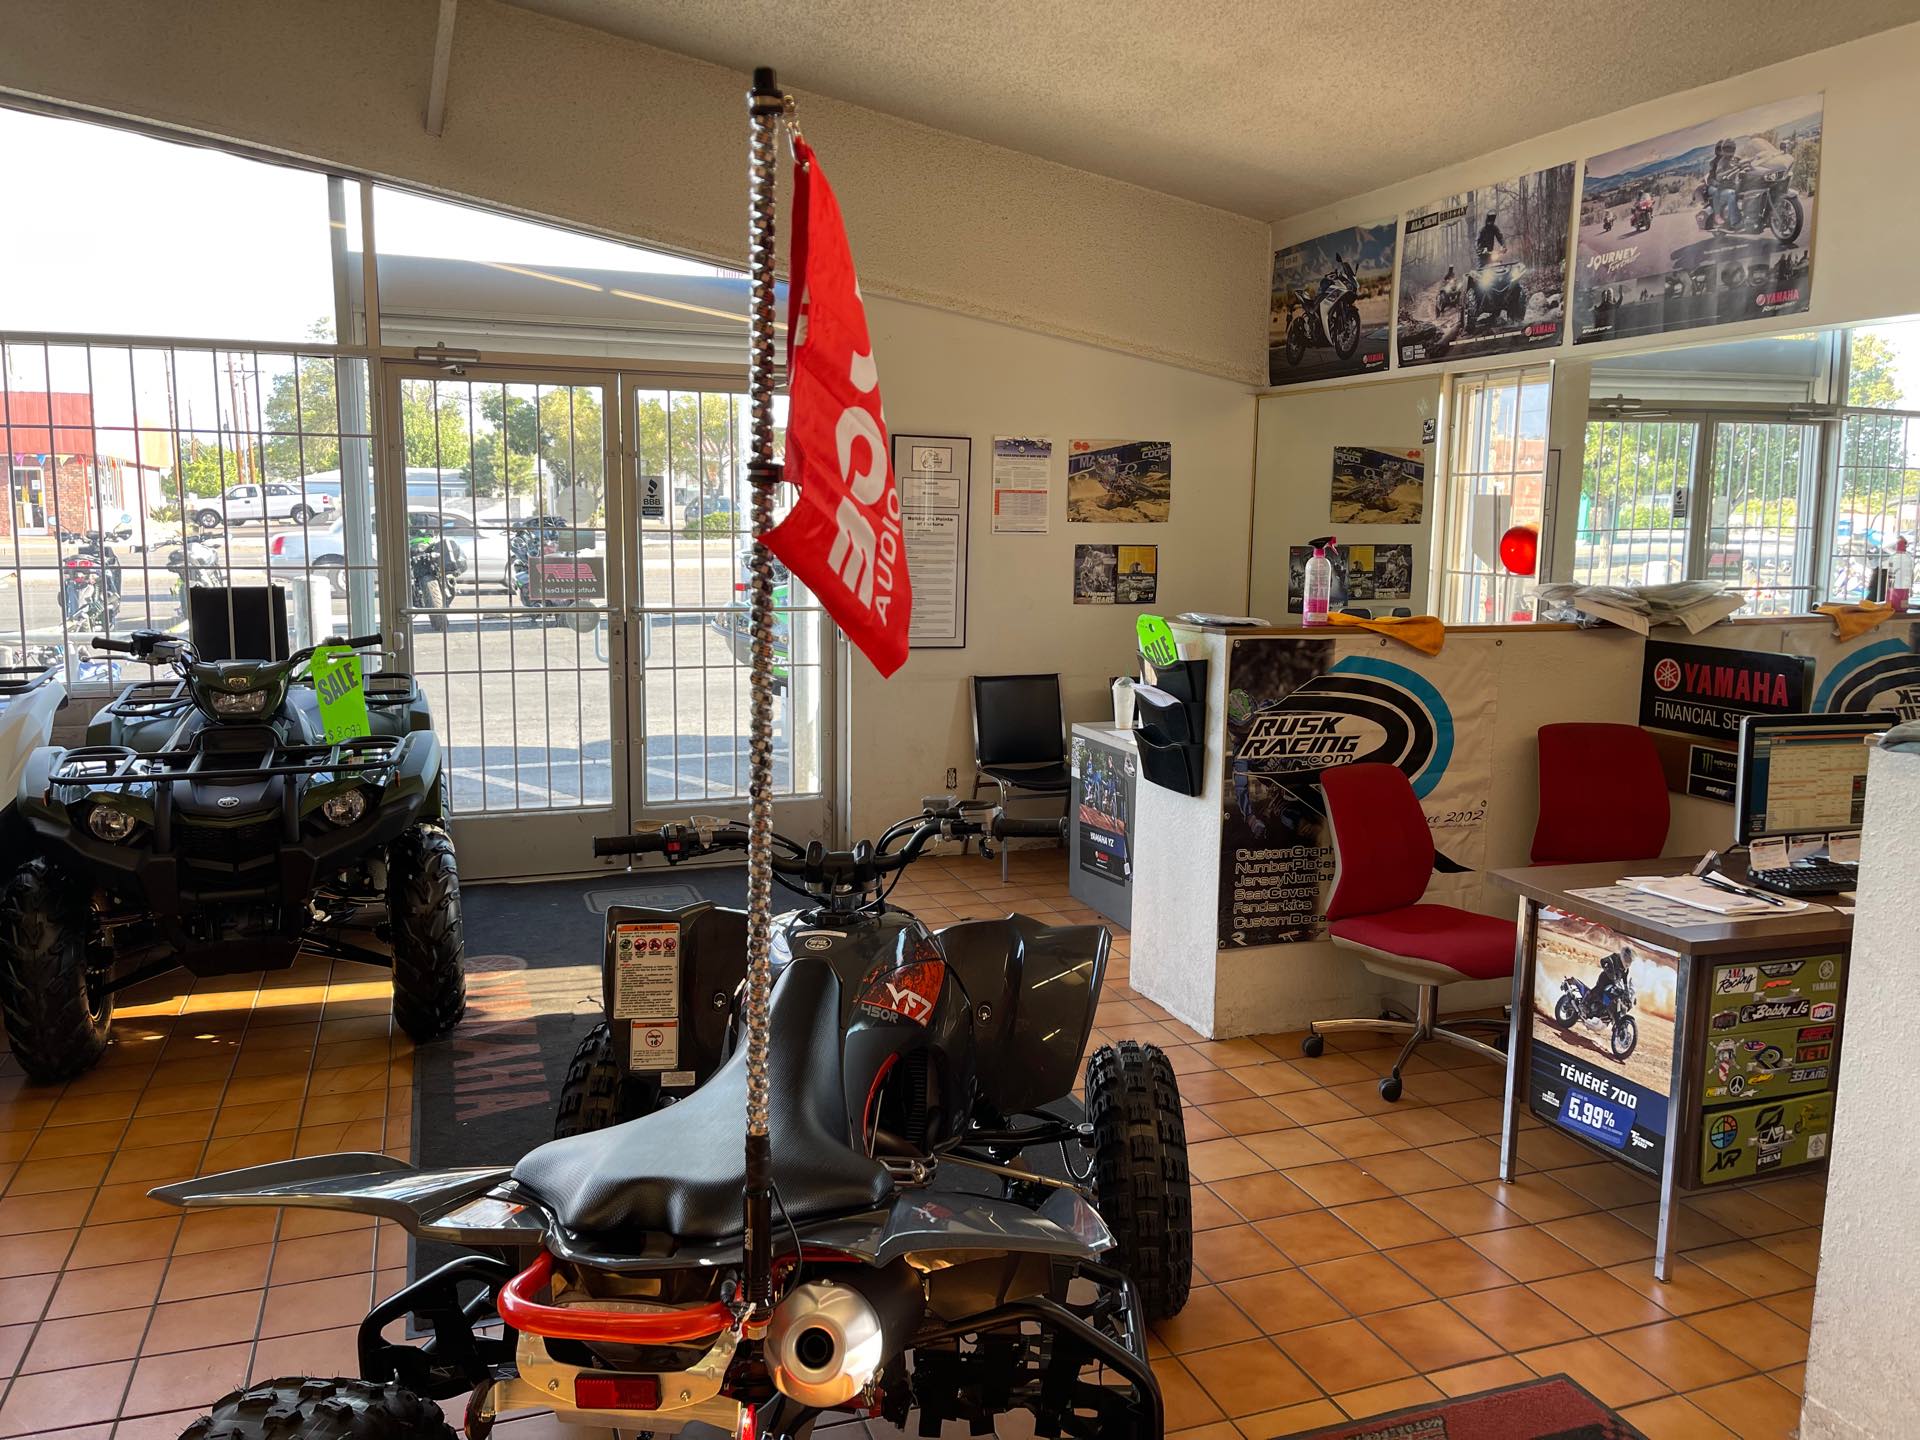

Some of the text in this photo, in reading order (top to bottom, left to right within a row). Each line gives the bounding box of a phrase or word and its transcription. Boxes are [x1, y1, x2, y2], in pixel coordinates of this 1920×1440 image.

[1440, 206, 1468, 222] GRIZZLY
[1586, 246, 1638, 270] JOURNEY
[1766, 289, 1800, 305] YAMAHA
[1531, 323, 1557, 335] YAMAHA
[874, 487, 901, 626] AUDIO
[1145, 636, 1174, 665] SALE
[318, 662, 359, 705] SALE
[1684, 662, 1789, 707] YAMAHA
[1654, 701, 1721, 728] FINANCIAL
[1251, 716, 1345, 738] RUSK
[1240, 735, 1361, 757] RACING
[1302, 754, 1354, 767] .com
[1444, 810, 1485, 823] 2002
[1089, 831, 1115, 848] YAMAHA YZ
[1234, 886, 1320, 901] SeatCovers
[1233, 899, 1313, 915] Fenderkits
[1717, 974, 1756, 994] Racing
[1812, 982, 1837, 992] YAMAHA
[860, 1003, 899, 1023] 450R
[885, 982, 933, 1027] YFZ
[1753, 1003, 1792, 1019] Bobby
[1814, 1008, 1832, 1019] 100%
[1800, 1047, 1829, 1060] YETI
[1560, 1062, 1637, 1110] TÉNÉRÉ 700
[1568, 1096, 1616, 1129] 5.99%
